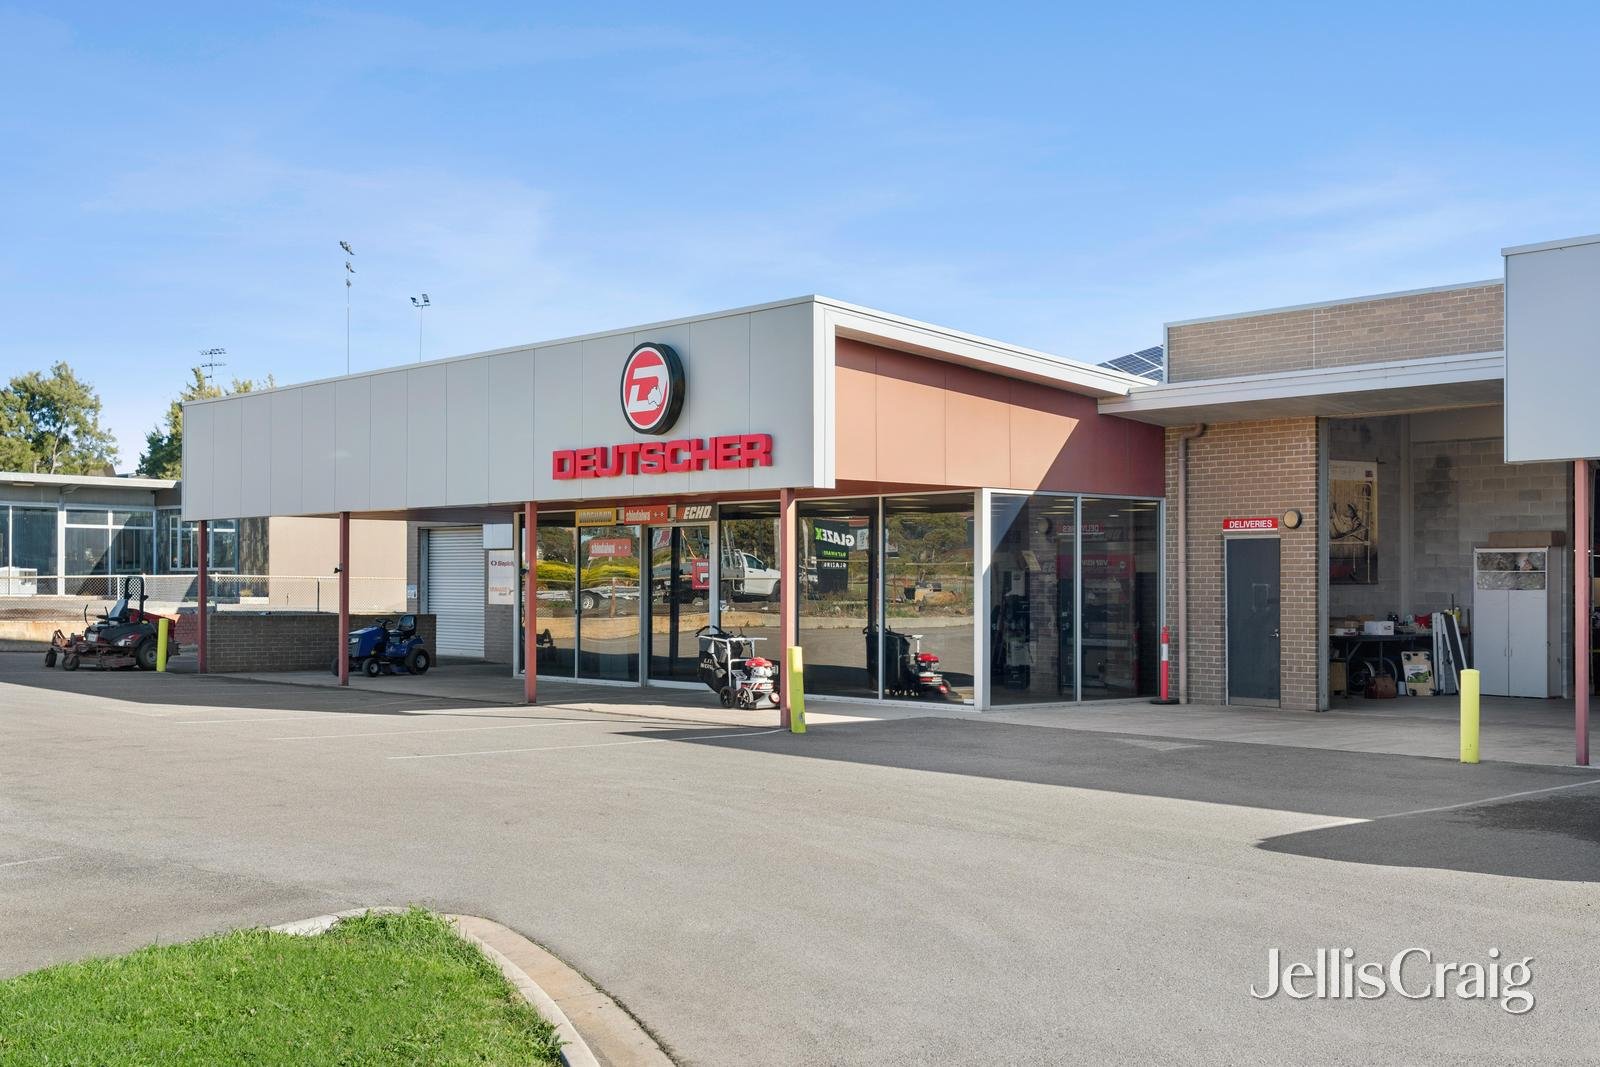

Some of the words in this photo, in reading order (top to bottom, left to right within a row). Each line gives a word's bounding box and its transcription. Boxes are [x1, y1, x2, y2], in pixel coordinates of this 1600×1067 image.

[552, 433, 773, 481] DEUTSCHER
[684, 506, 711, 519] ECHO
[1229, 520, 1272, 528] DELIVERIES
